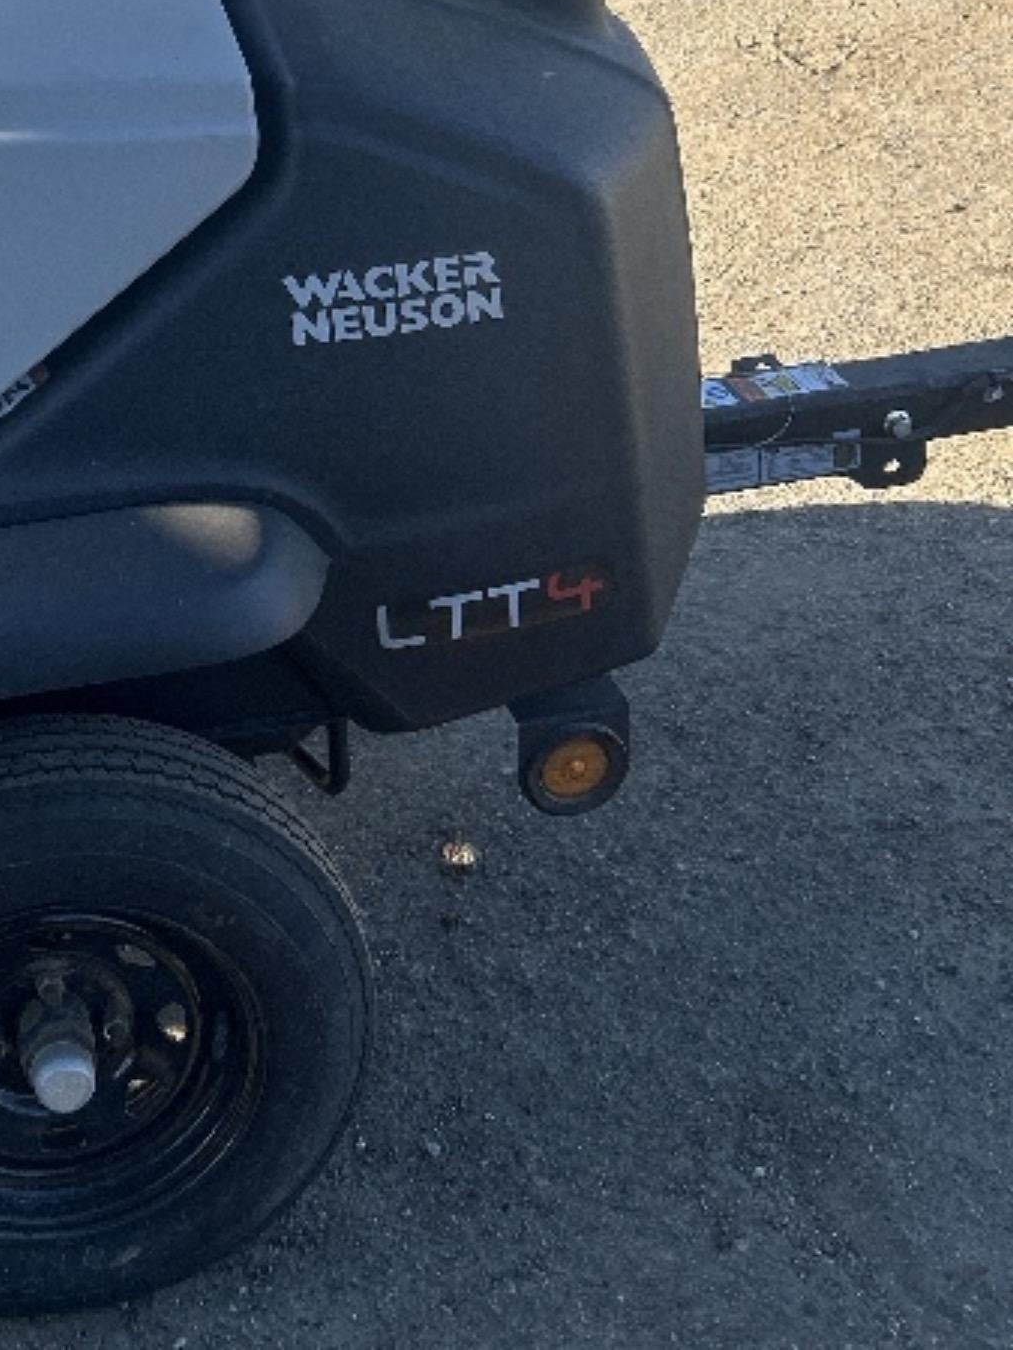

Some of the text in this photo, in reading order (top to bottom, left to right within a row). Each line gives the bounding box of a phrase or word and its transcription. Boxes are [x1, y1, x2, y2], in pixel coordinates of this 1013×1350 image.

[281, 250, 501, 308] WACKER
[290, 286, 504, 347] NEUSON
[375, 570, 603, 649] LTT4
